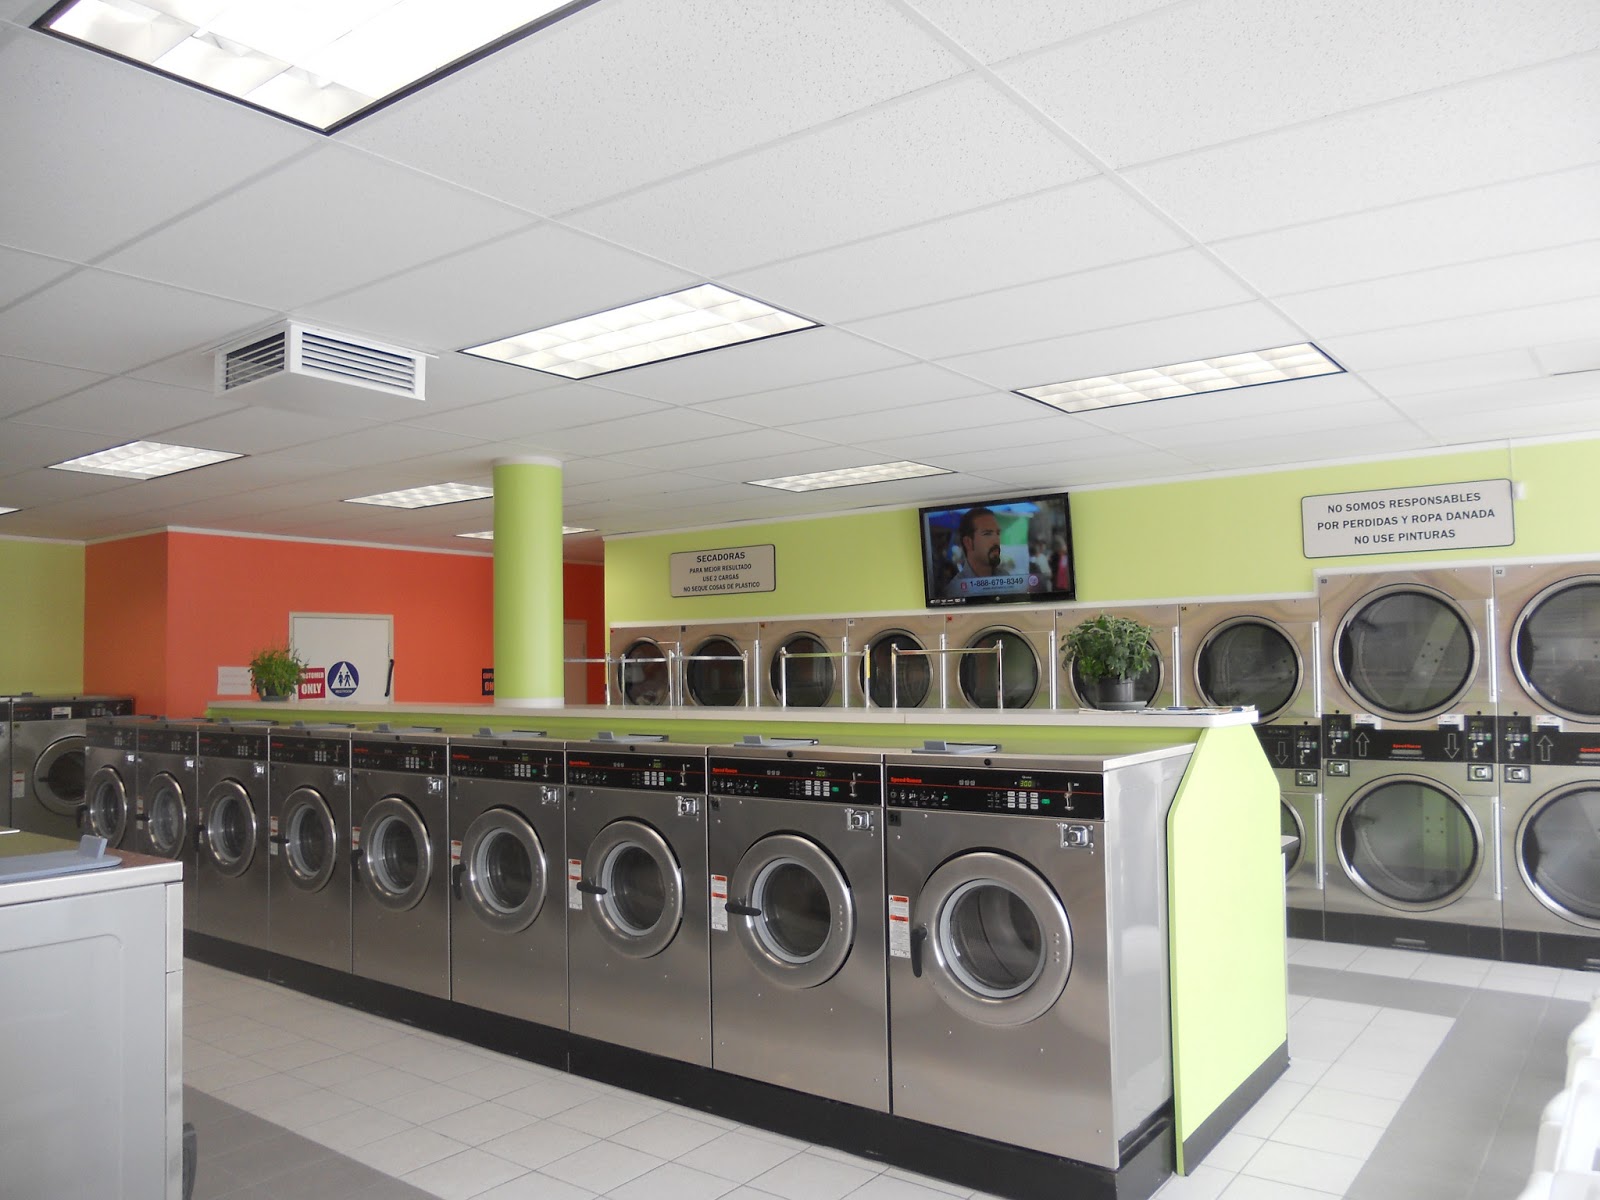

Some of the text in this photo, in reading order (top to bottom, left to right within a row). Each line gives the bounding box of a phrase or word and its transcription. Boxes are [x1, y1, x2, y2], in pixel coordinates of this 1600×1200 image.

[1328, 492, 1481, 513] NO SOMOS RESPONSABLES
[1317, 509, 1495, 531] POR PERDIDAS Y ROPA DANADA
[1354, 529, 1456, 544] NO USE PINTURAS
[697, 552, 745, 563] SECADORAS
[970, 578, 1024, 587] 1-888-679-8349
[302, 683, 321, 694] ONLY
